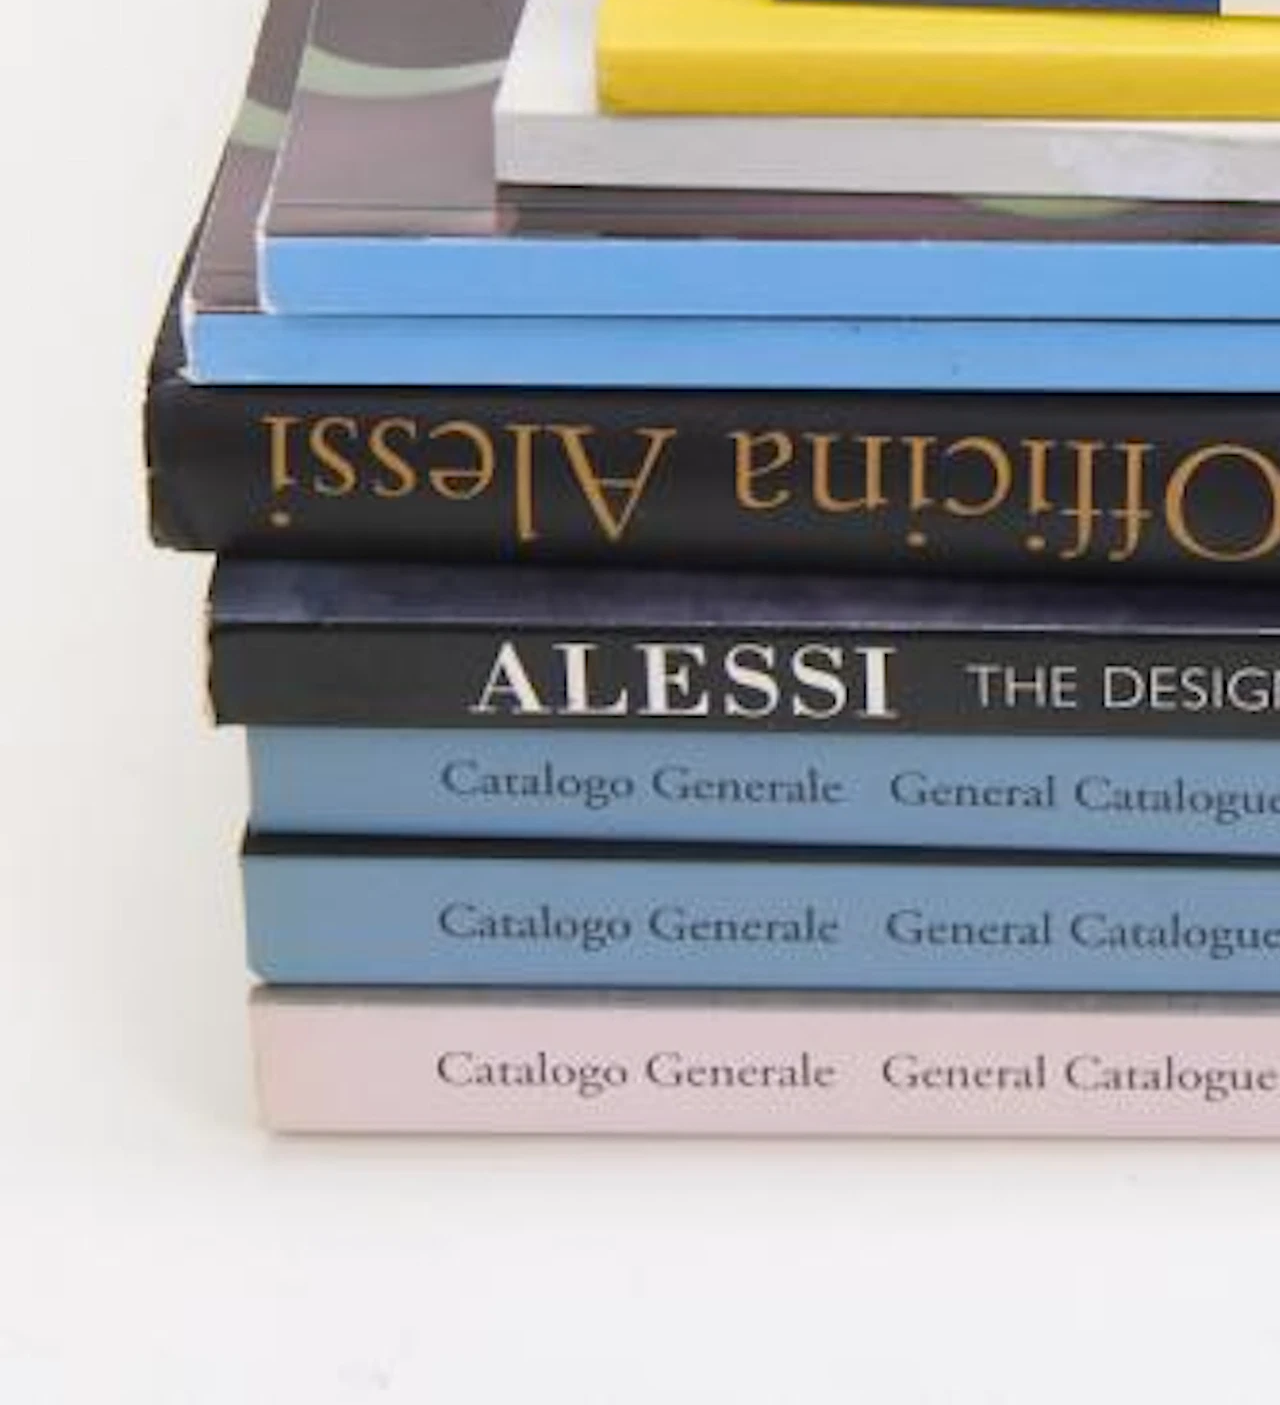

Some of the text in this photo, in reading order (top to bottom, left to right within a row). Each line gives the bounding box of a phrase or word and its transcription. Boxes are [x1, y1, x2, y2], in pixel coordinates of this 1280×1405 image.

[258, 412, 678, 545] Alessi
[469, 640, 901, 719] ALESSI
[966, 665, 1079, 710] THE
[439, 755, 636, 806] Catalogo
[652, 763, 845, 806] Generale
[888, 766, 1056, 810] General
[437, 898, 634, 948] Catalogo
[648, 905, 840, 946] Generale
[885, 908, 1053, 948] General
[436, 1048, 630, 1095] Catalogo
[644, 1051, 836, 1093] Generale
[880, 1052, 1048, 1093] General
[1064, 1053, 1279, 1102] Catalogue
